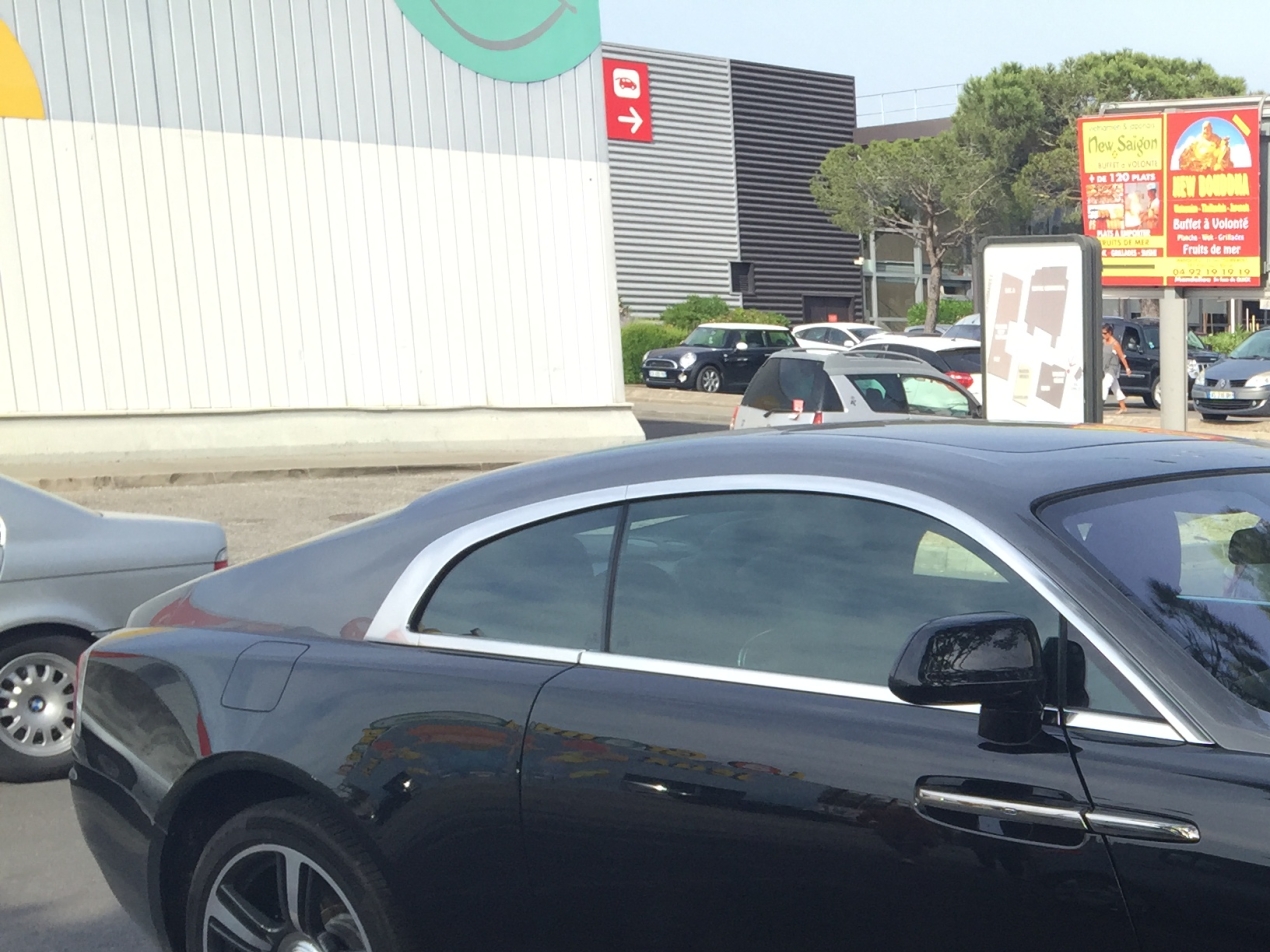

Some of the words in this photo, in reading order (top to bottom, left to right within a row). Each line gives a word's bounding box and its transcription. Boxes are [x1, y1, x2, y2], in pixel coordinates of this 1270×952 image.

[1088, 135, 1114, 153] New
[1096, 175, 1107, 183] DE
[1109, 172, 1130, 182] 120
[1132, 173, 1156, 182] PLATS
[1172, 218, 1202, 230] Buffet
[1204, 217, 1210, 230] à
[1212, 217, 1249, 230] Volonté
[1182, 244, 1208, 255] Fruits
[1210, 244, 1222, 255] de
[1223, 245, 1242, 255] mer
[1188, 268, 1201, 276] 92
